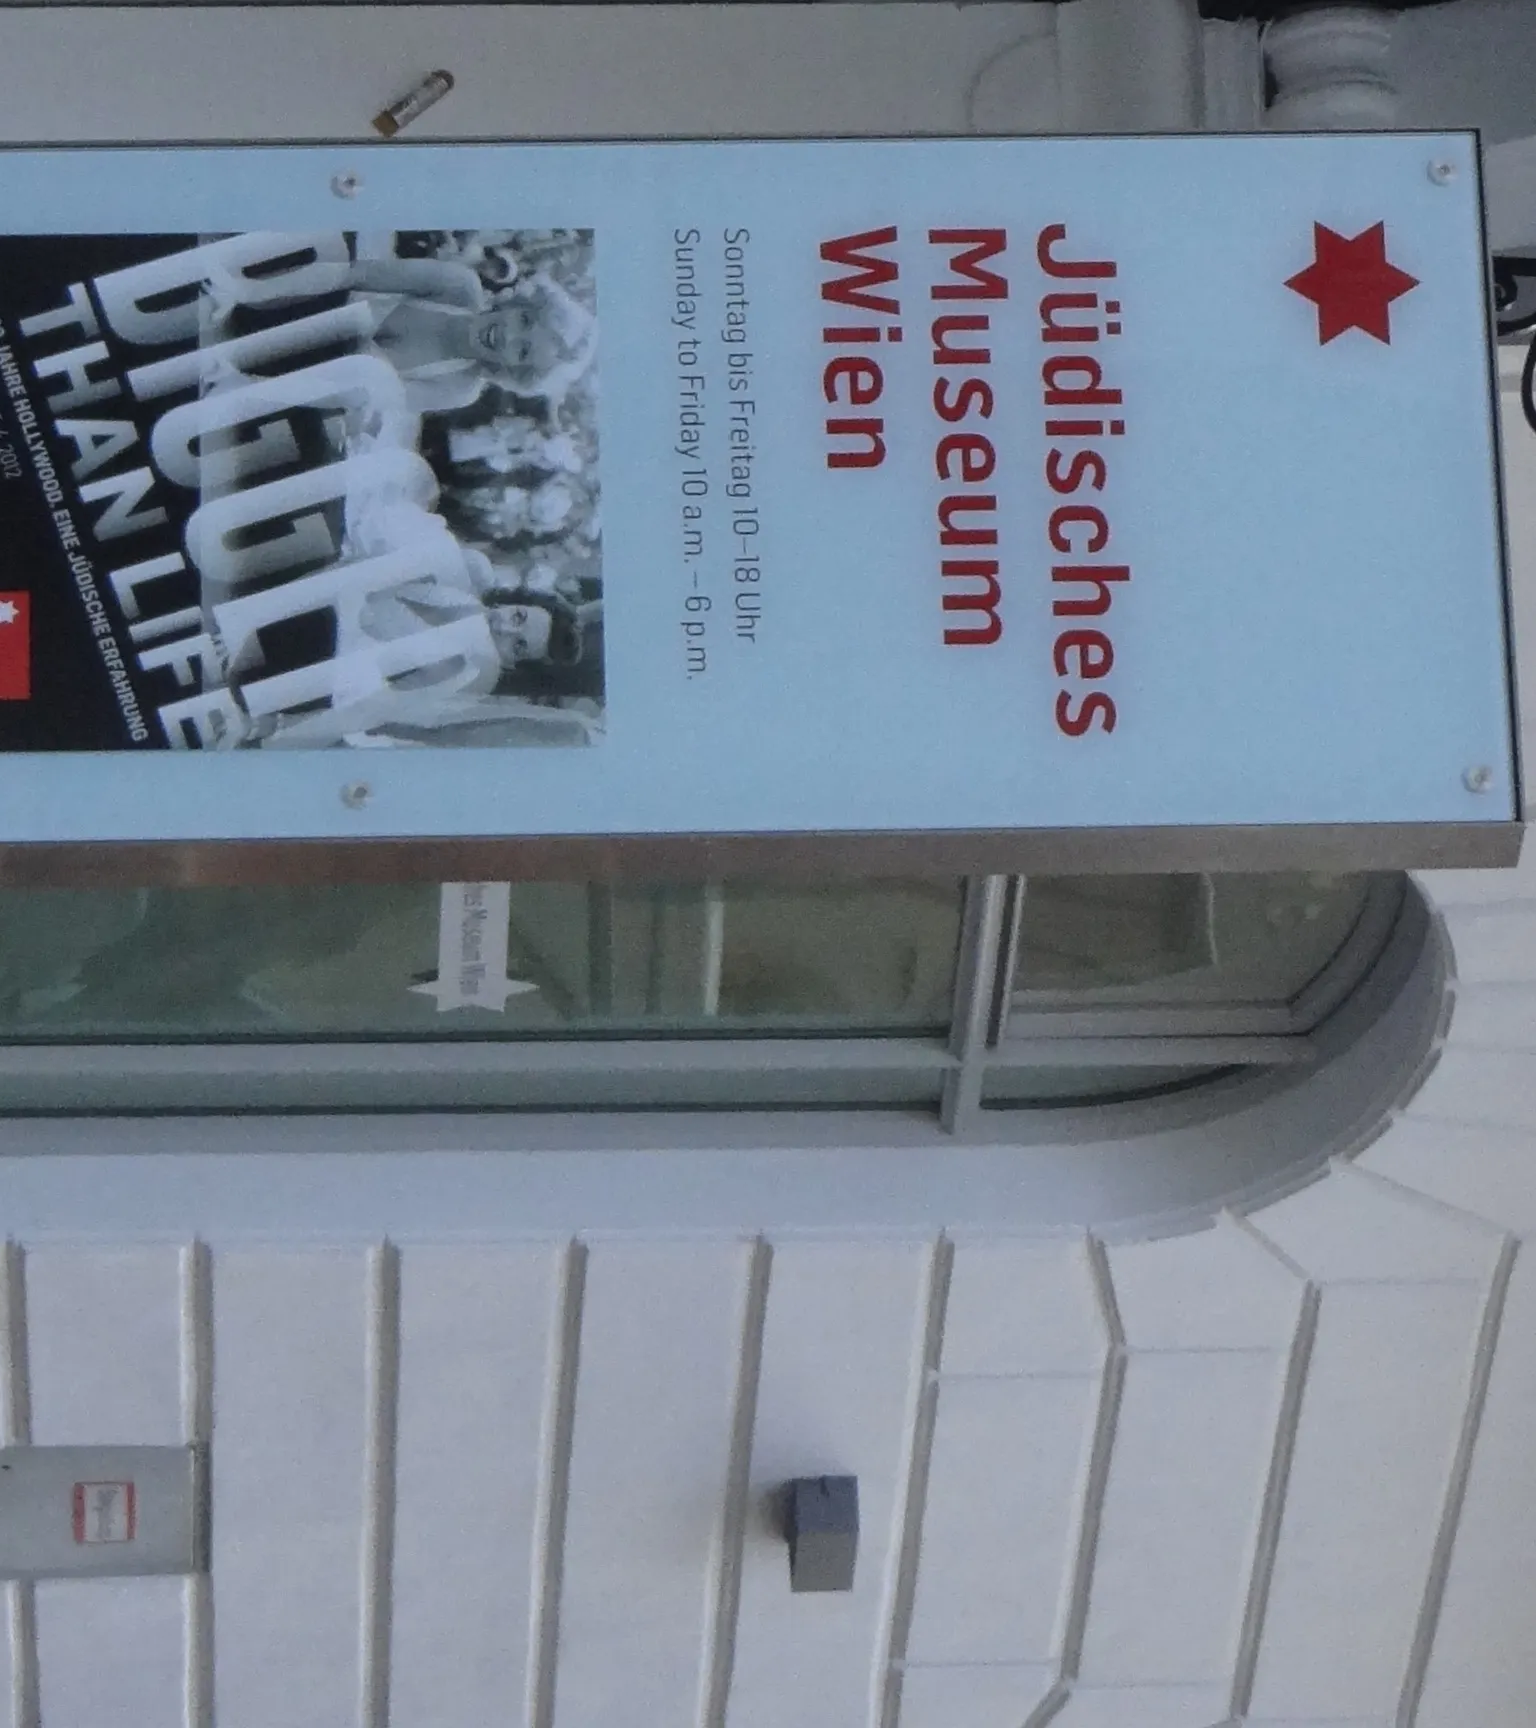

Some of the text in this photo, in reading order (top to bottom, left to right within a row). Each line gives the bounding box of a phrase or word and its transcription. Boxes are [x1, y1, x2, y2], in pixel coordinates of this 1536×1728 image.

[671, 227, 702, 331] Sunday
[721, 227, 751, 344] Sonntag
[677, 338, 703, 367] to
[727, 352, 756, 392] bis
[820, 227, 900, 469] Wien
[18, 283, 169, 543] THAN
[674, 374, 706, 460] Friday
[725, 399, 757, 498] Freitag
[929, 228, 1010, 645] Museum
[92, 232, 500, 752] BIGGER
[681, 468, 709, 497] 10
[1038, 224, 1127, 736] Jüdisches
[12, 398, 67, 509] HOLLYWOOD.
[51, 508, 81, 550] EINE
[67, 552, 113, 637] JÜDISCHE
[97, 636, 150, 742] ERFAHRUNG
[682, 504, 705, 564] a.m.
[108, 551, 239, 750] LIFE
[680, 621, 709, 681] p.m.
[684, 595, 713, 613] 6
[734, 592, 762, 644] Uhr
